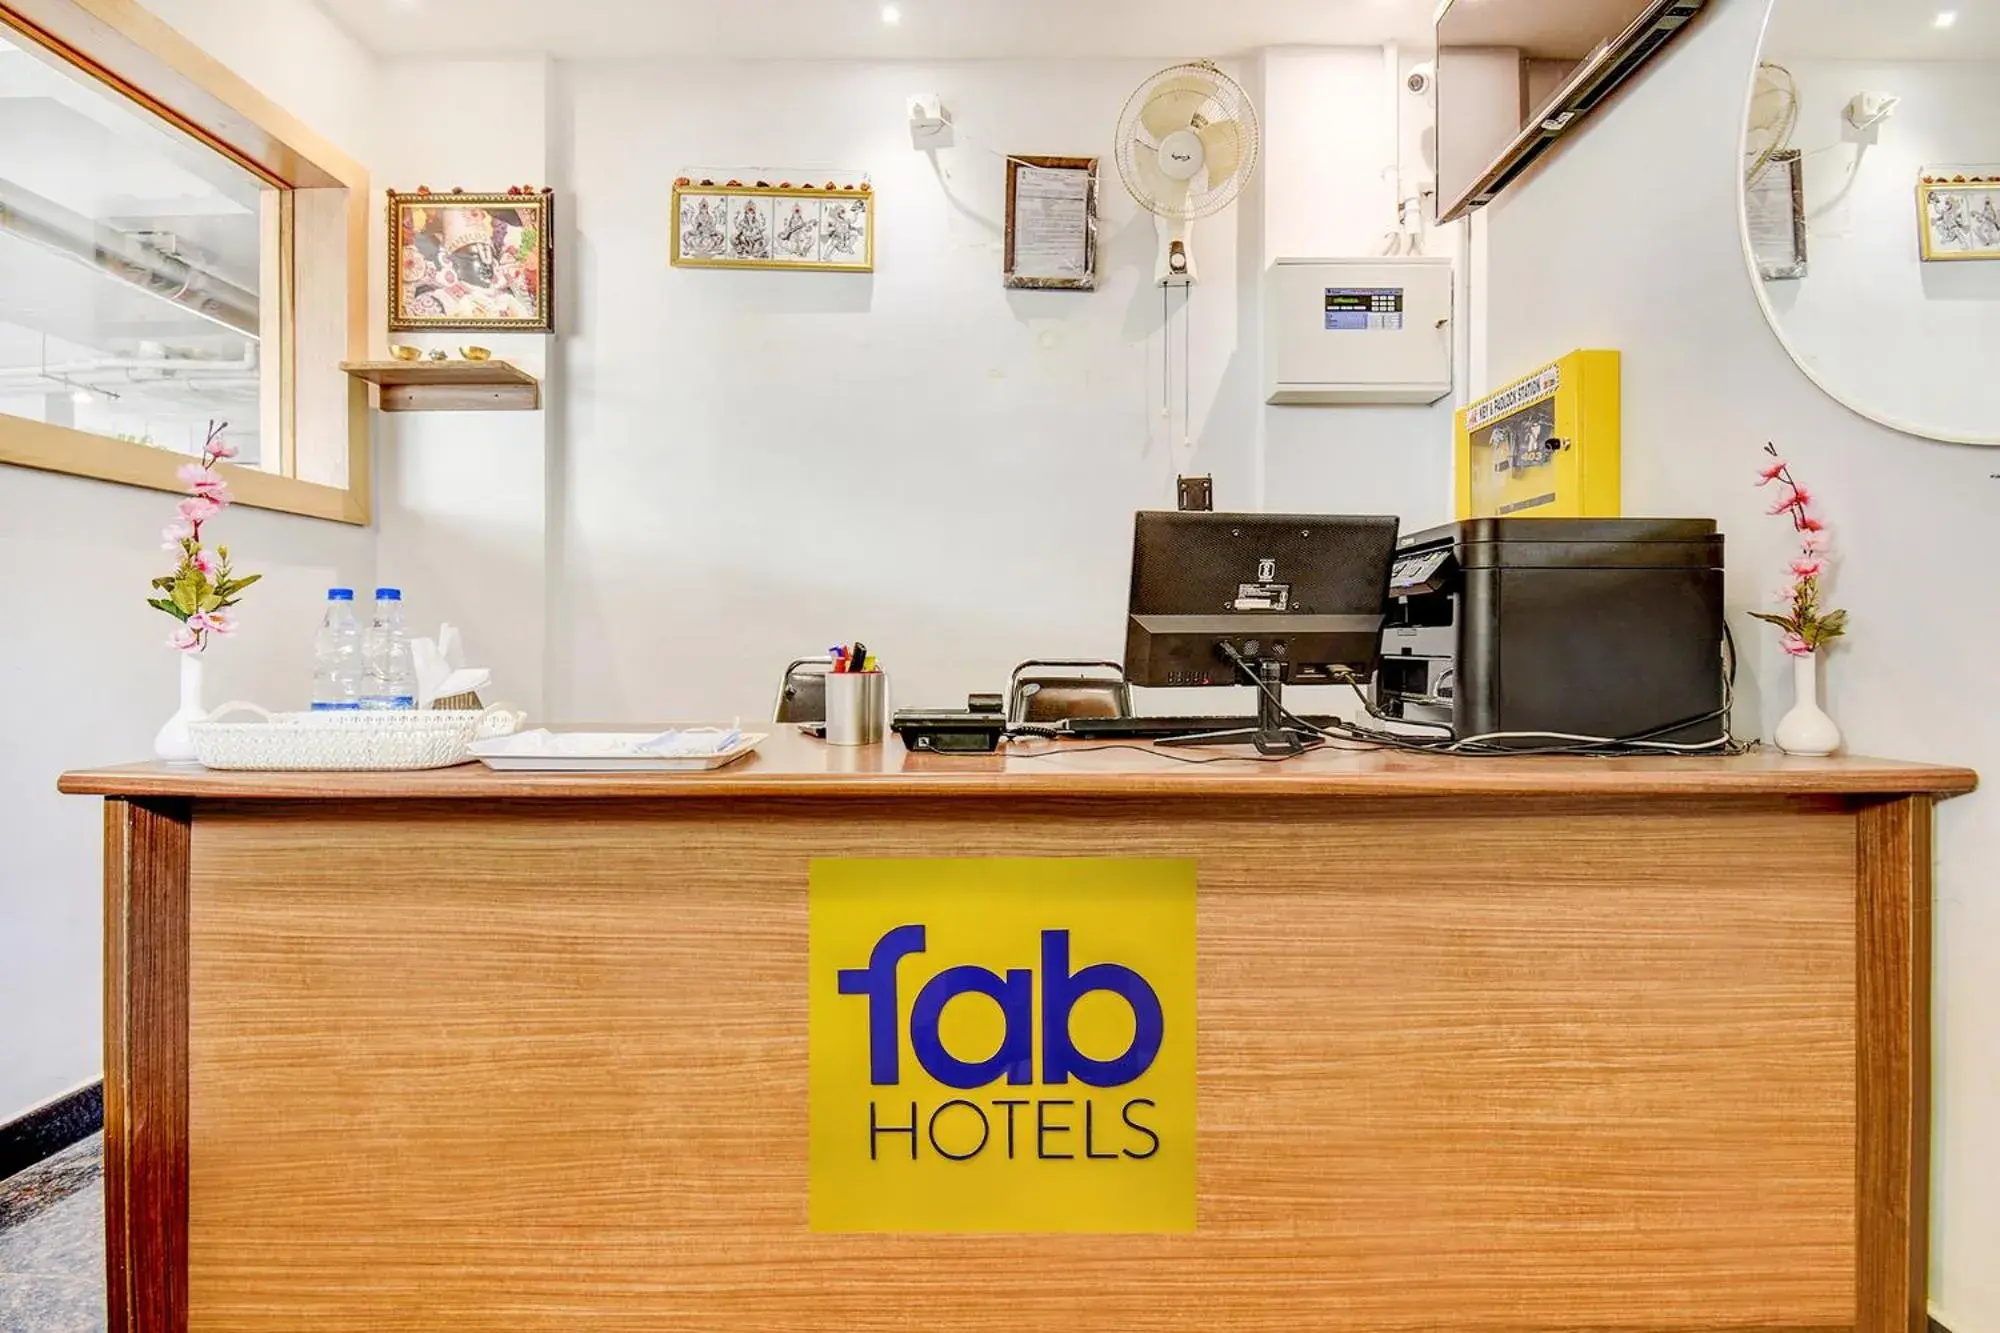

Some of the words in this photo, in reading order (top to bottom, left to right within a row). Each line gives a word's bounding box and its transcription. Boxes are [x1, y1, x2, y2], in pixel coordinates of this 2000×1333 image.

[1479, 402, 1489, 420] KEY
[1494, 390, 1517, 413] PADLOCK
[1517, 376, 1541, 402] STATION
[837, 924, 1164, 1089] fab
[870, 1098, 1160, 1161] HOTELS
